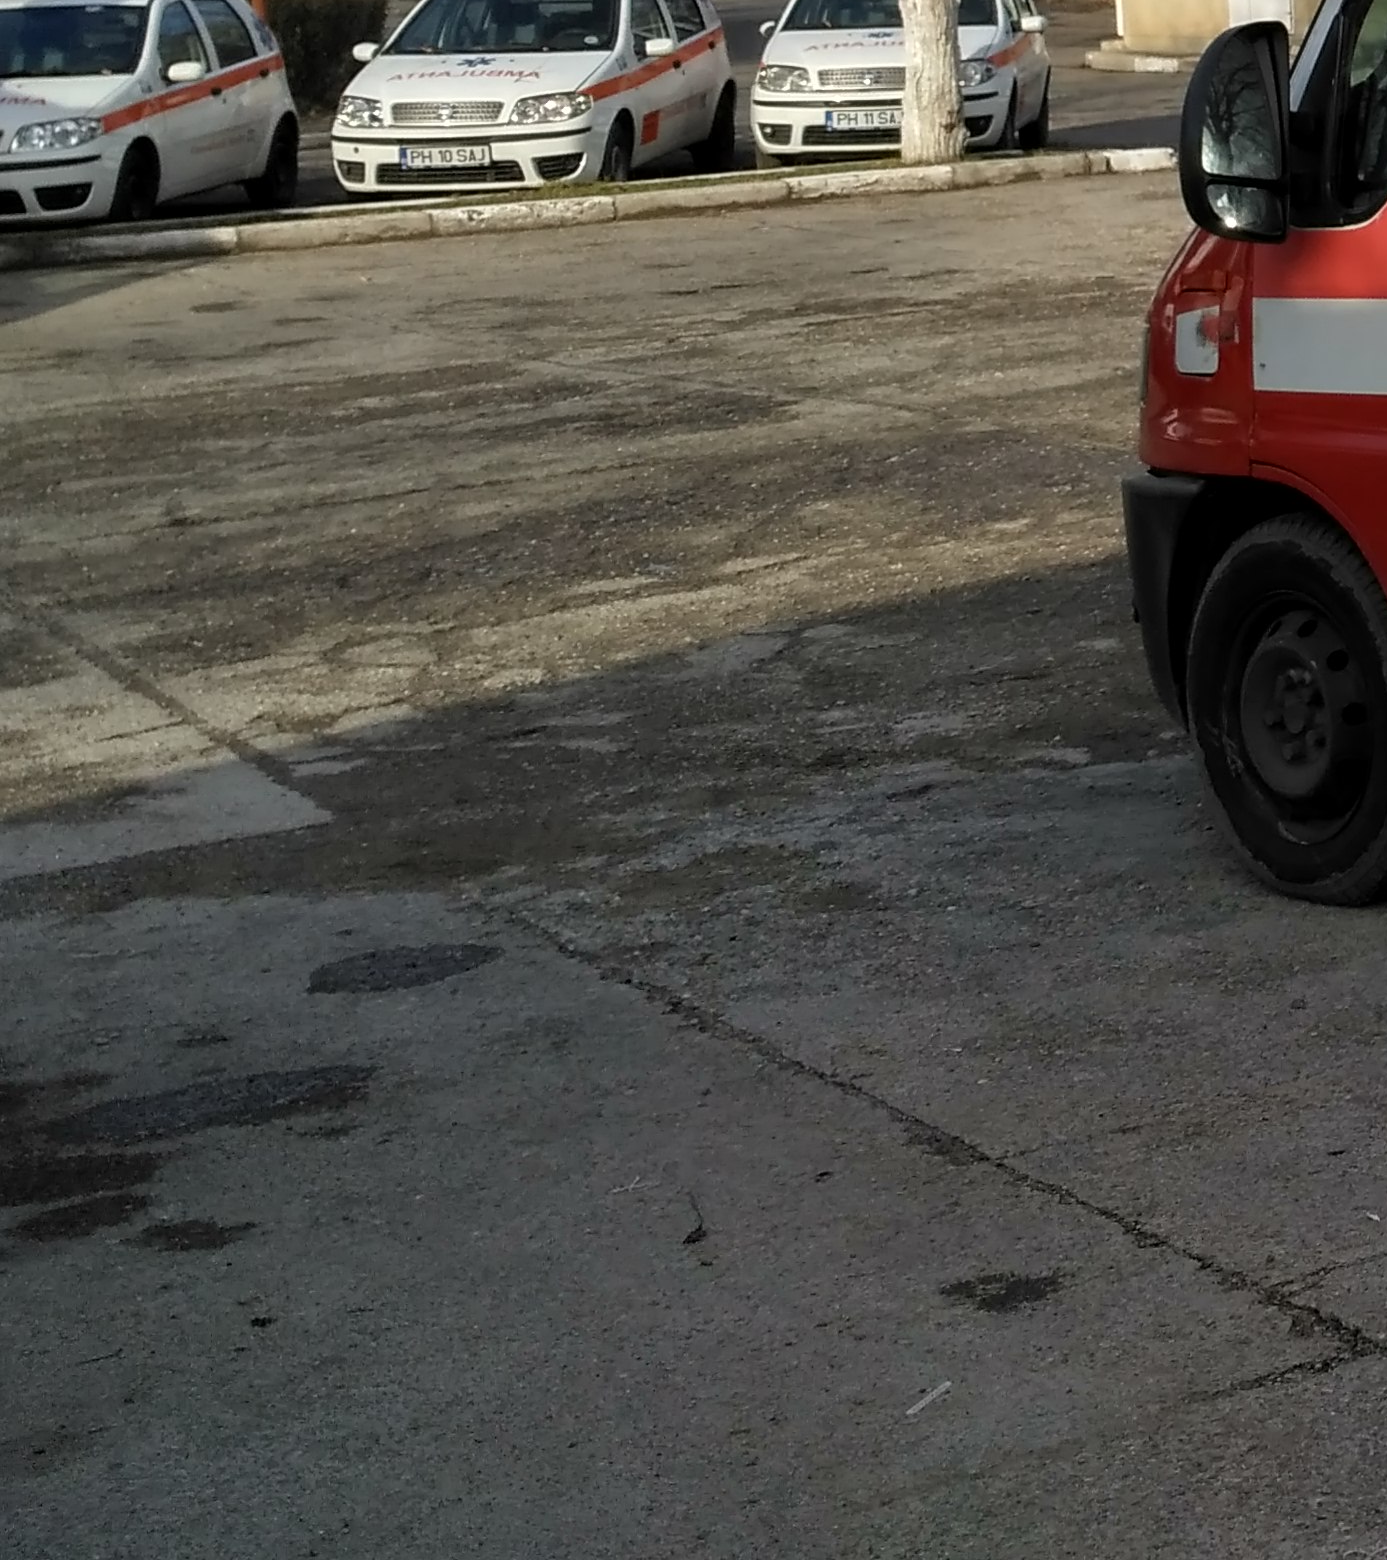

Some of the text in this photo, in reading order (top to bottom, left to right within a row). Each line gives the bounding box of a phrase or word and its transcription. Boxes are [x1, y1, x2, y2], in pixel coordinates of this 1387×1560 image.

[837, 113, 858, 125] PH
[864, 112, 874, 124] 11
[410, 148, 485, 164] PH 10 SAJ
